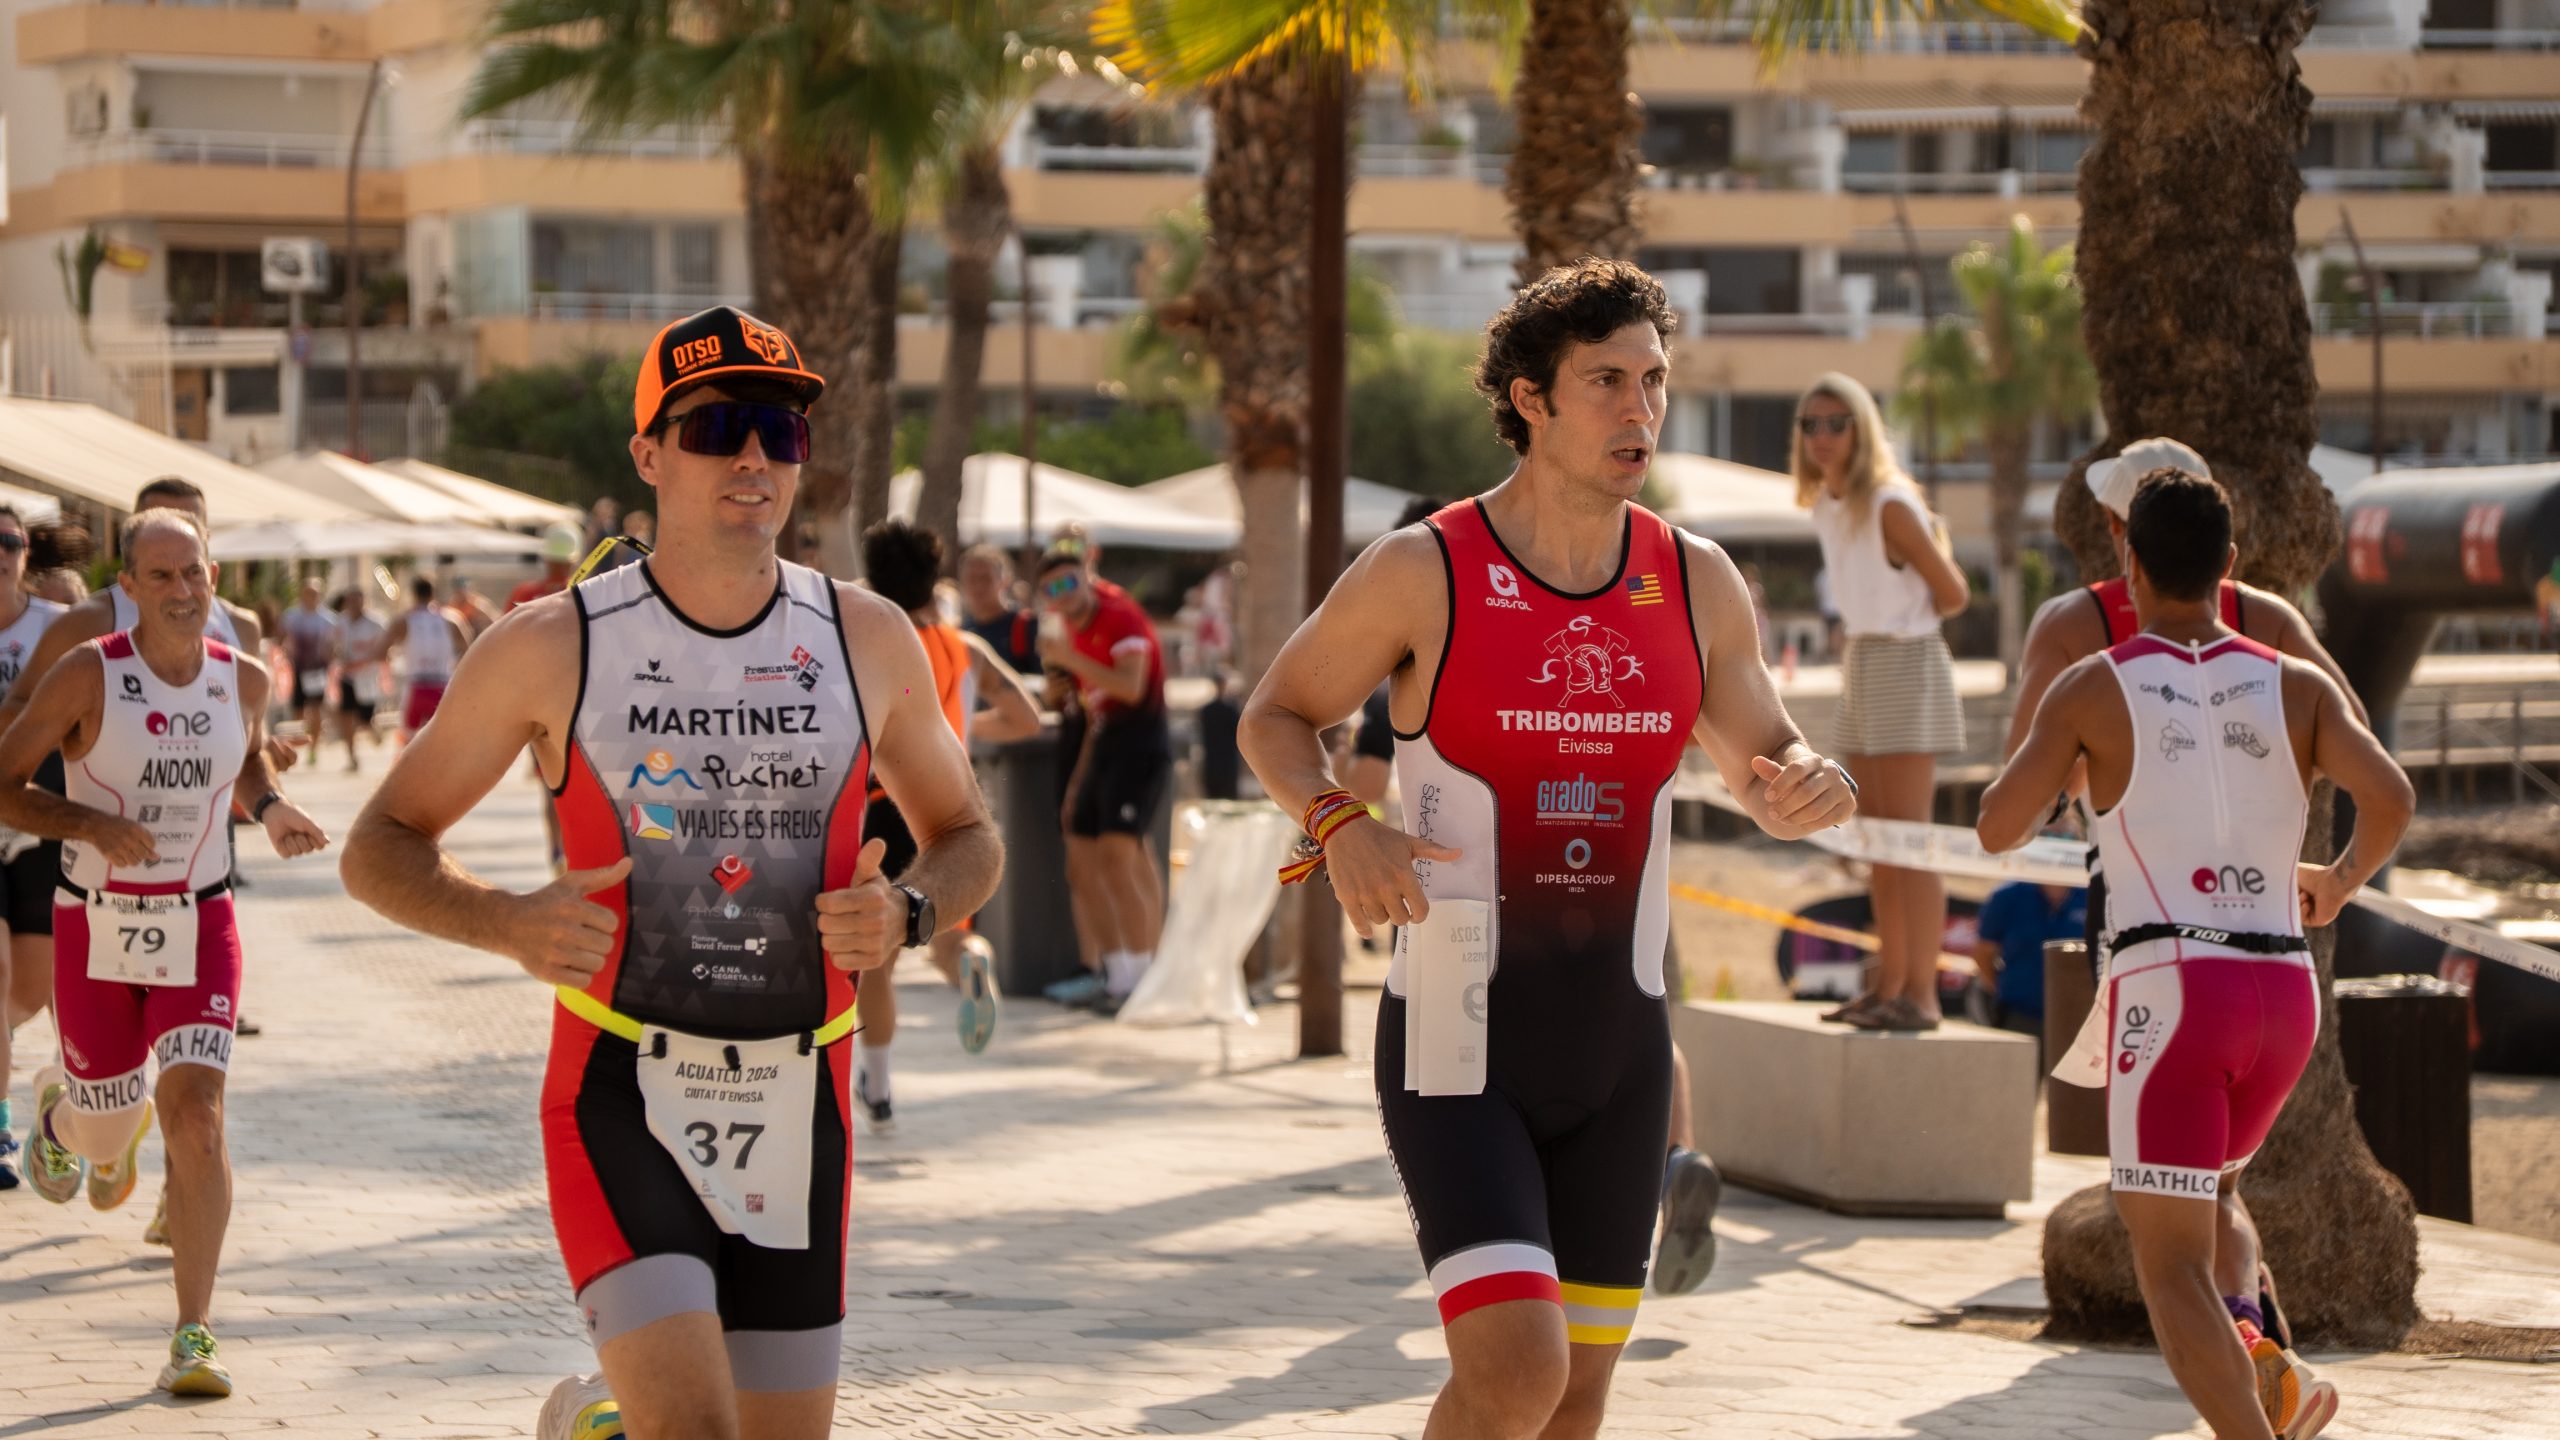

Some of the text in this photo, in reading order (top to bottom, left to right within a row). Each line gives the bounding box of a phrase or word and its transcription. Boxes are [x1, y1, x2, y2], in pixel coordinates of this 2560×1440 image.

[673, 335, 721, 369] OTSO
[1486, 597, 1533, 612] austral
[628, 699, 821, 736] MARTÍNEZ
[1496, 710, 1673, 733] TRIBOMBERS
[751, 751, 792, 762] hotel
[1558, 738, 1614, 754] Eivissa
[138, 757, 212, 789] ANDONI
[701, 755, 826, 790] Puchet
[677, 810, 822, 839] VIAJES ES FREUS
[1415, 783, 1435, 888] UPECARS
[1536, 874, 1616, 885] DIPESAGROUP
[118, 926, 166, 954] 79
[691, 941, 715, 950] David
[746, 1065, 779, 1083] 2026
[684, 1087, 717, 1100] CIUTAT
[684, 1121, 765, 1170] 37
[2117, 1168, 2216, 1194] TRIATHLO
